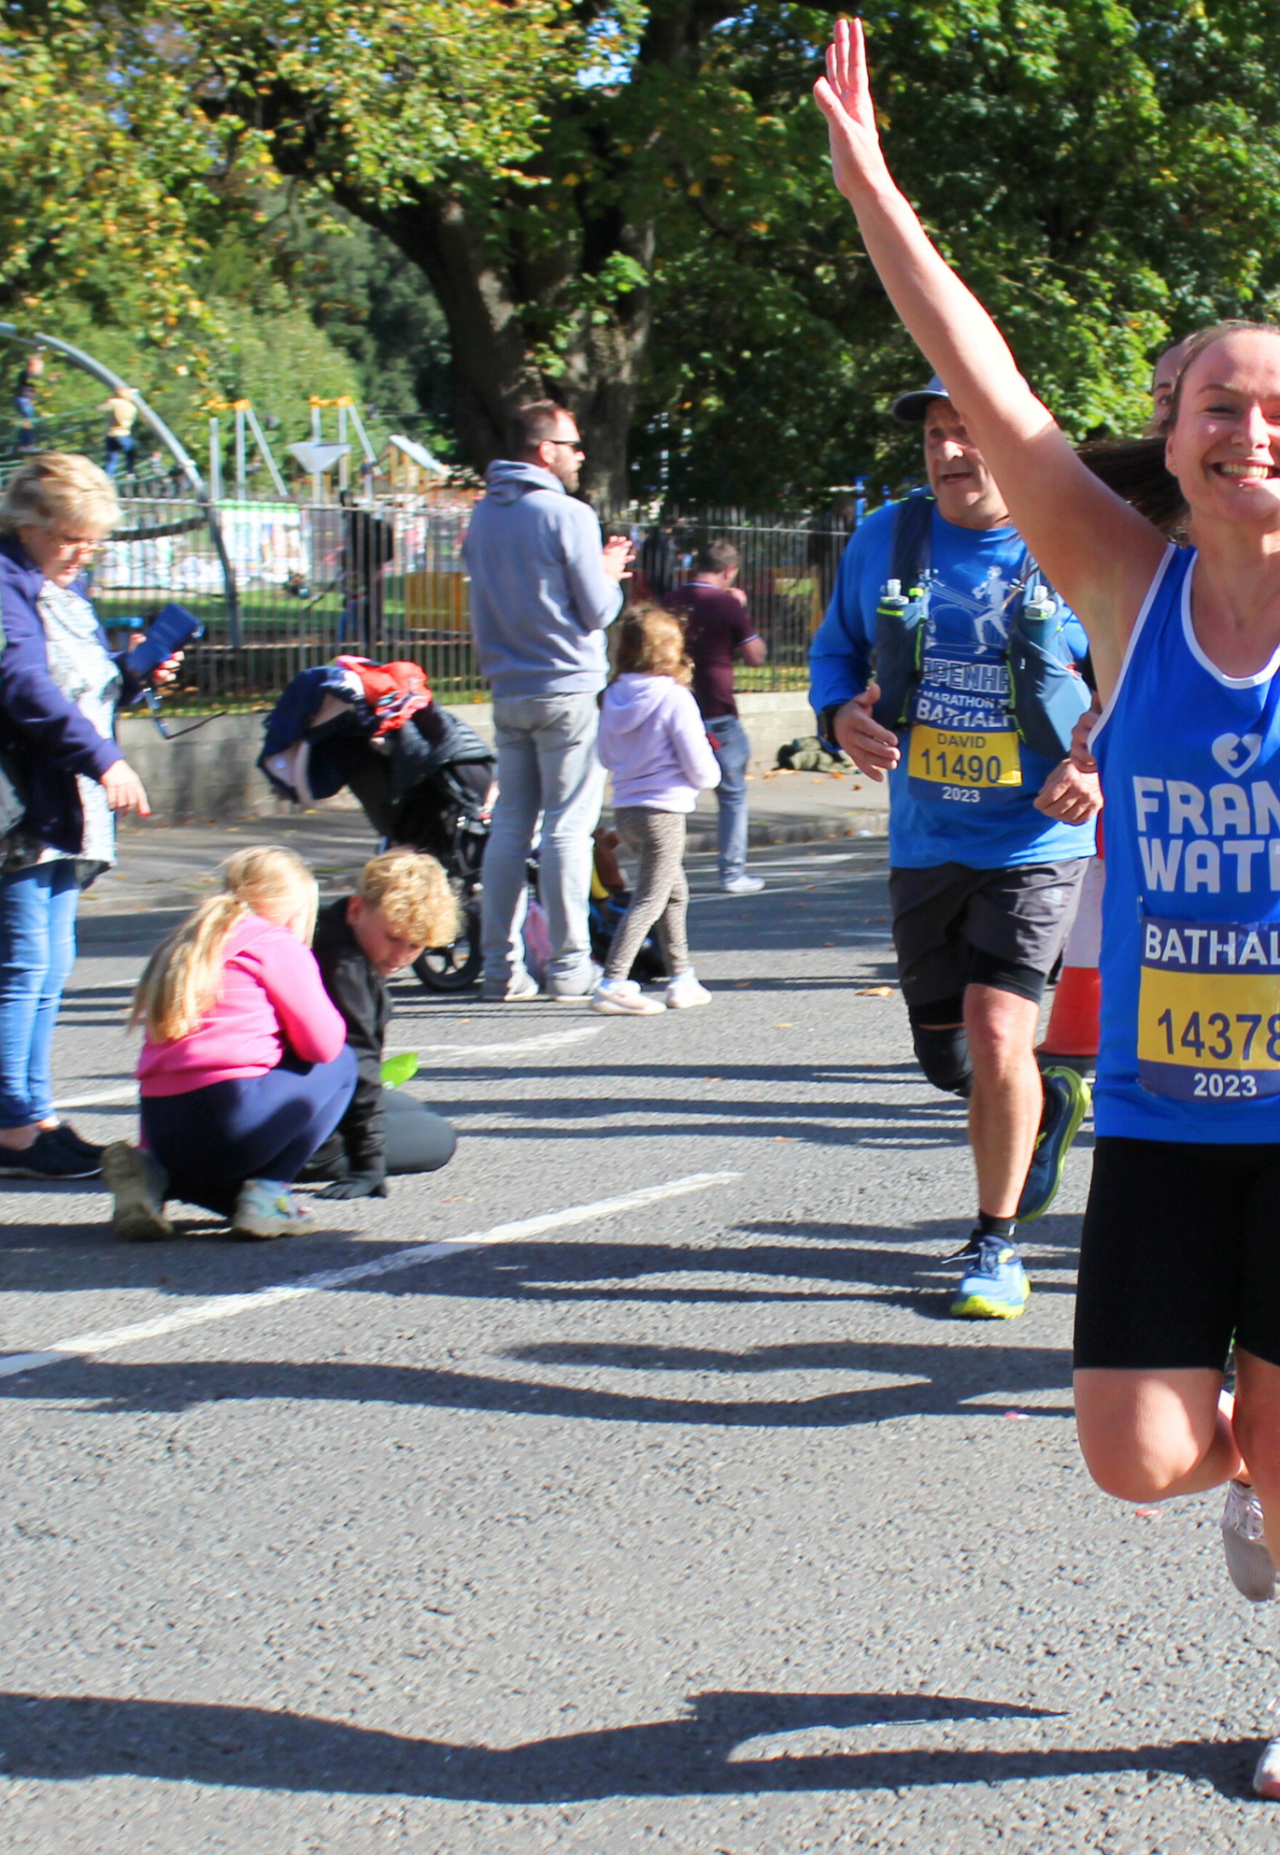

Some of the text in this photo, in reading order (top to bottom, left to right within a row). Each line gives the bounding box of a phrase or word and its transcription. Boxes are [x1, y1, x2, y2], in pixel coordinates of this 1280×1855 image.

[937, 733, 986, 748] DAVID
[921, 748, 1001, 783] 11490
[942, 786, 981, 803] 2023
[1193, 1073, 1258, 1097] 2023
